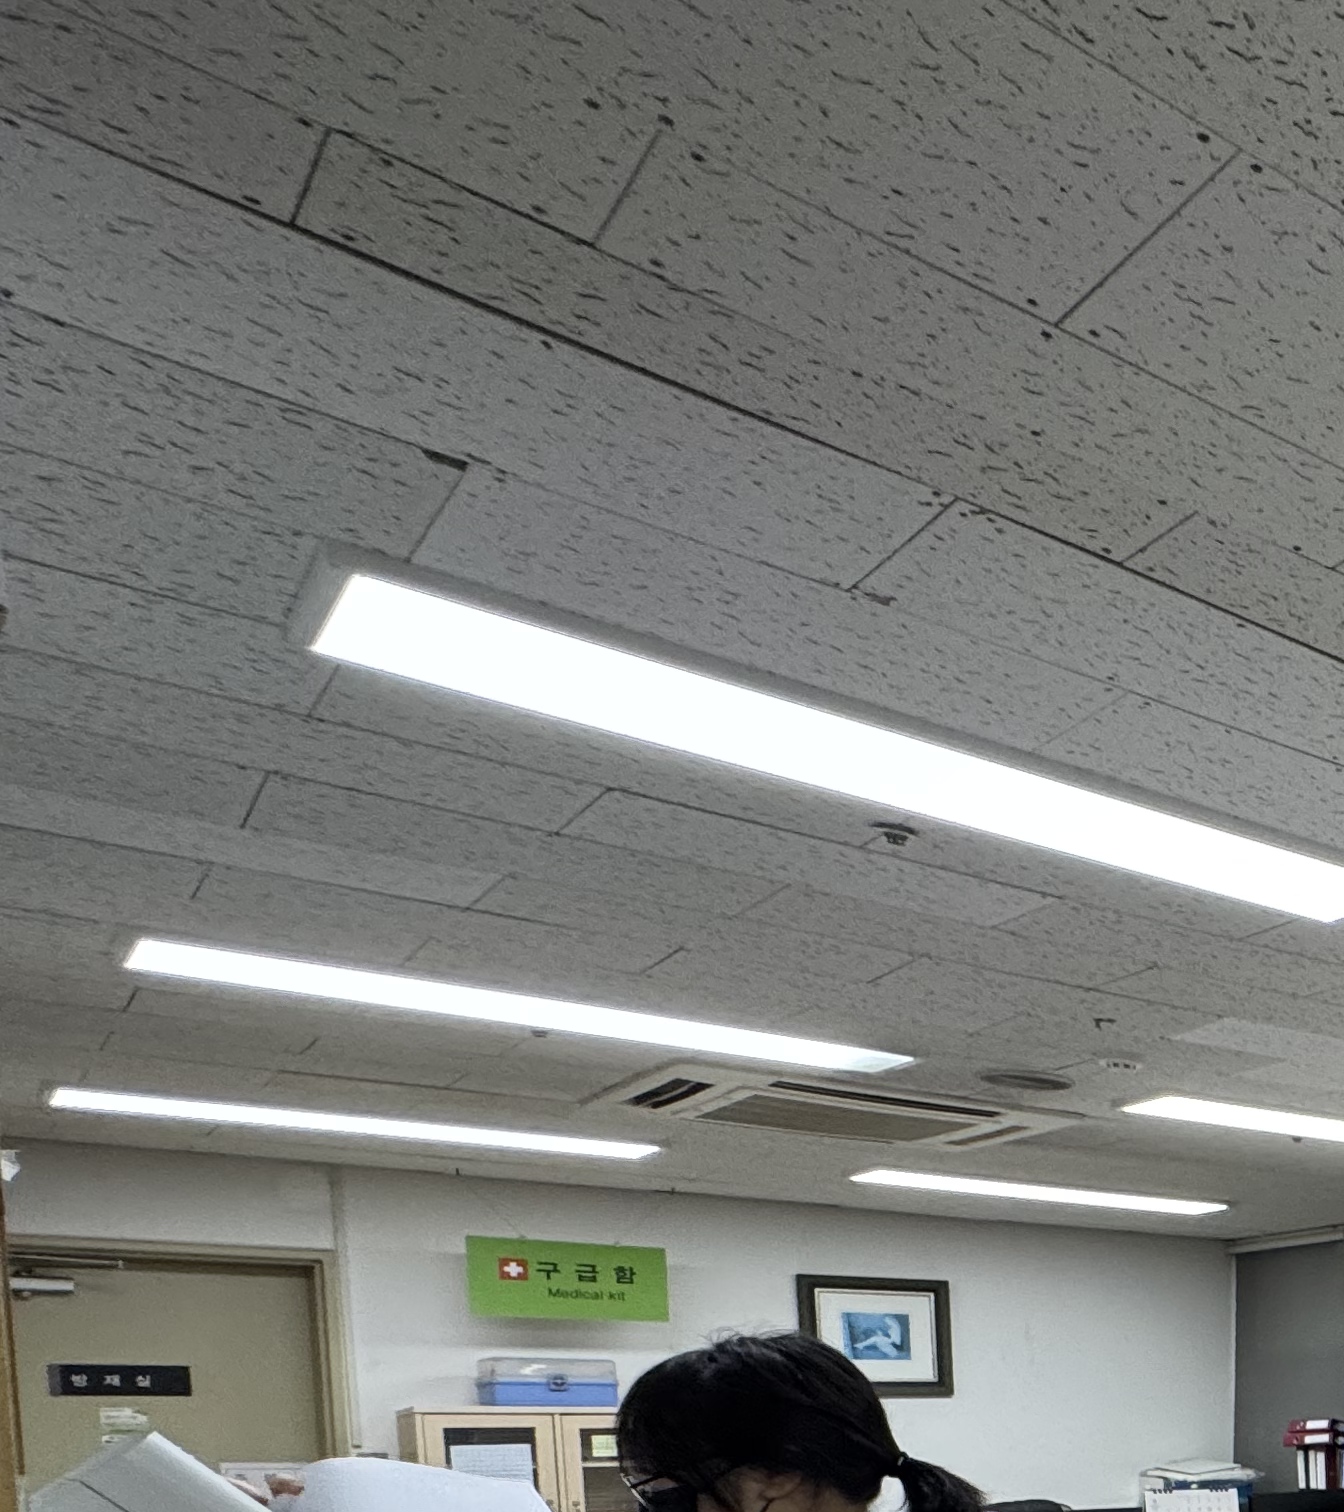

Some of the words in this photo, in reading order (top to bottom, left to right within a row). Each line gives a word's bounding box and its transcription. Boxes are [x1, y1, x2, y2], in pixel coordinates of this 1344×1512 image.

[535, 1260, 637, 1285] 구급함
[547, 1286, 604, 1301] Medical
[607, 1290, 626, 1301] kit
